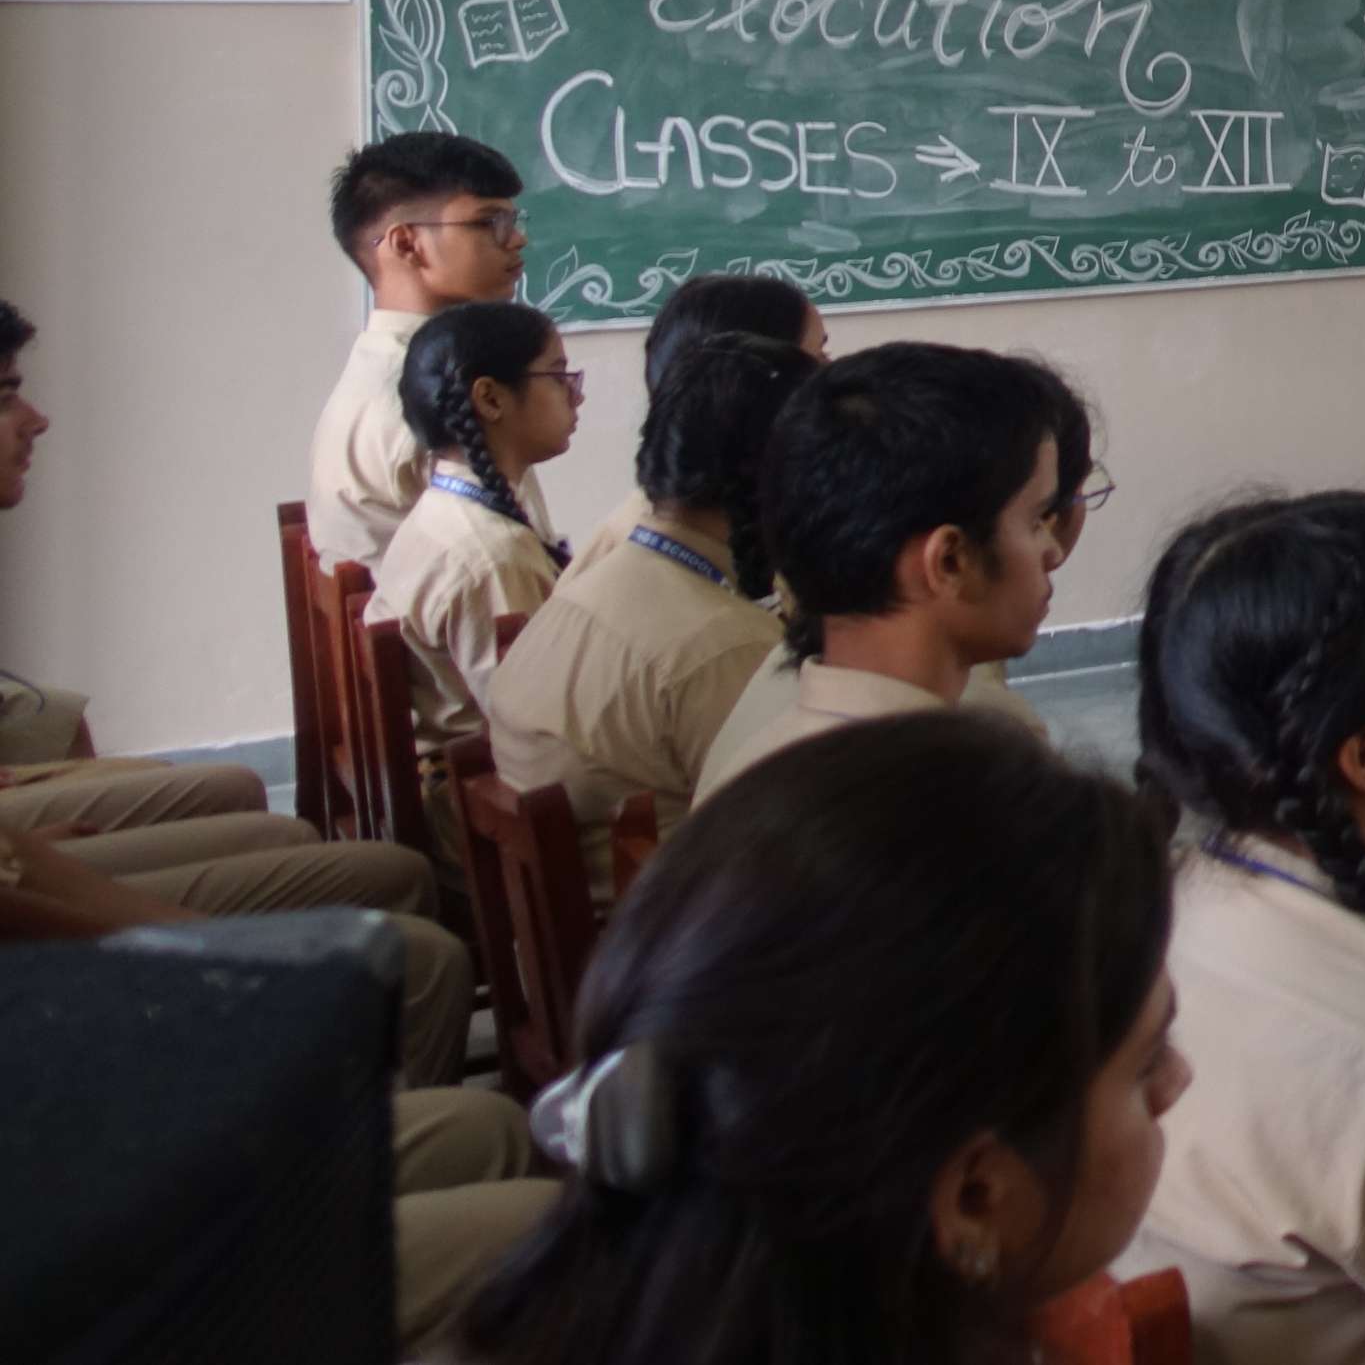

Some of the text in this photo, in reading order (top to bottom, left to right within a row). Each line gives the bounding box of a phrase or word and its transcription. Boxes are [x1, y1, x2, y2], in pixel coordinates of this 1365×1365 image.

[541, 68, 1293, 199] CLASSES IX to XII
